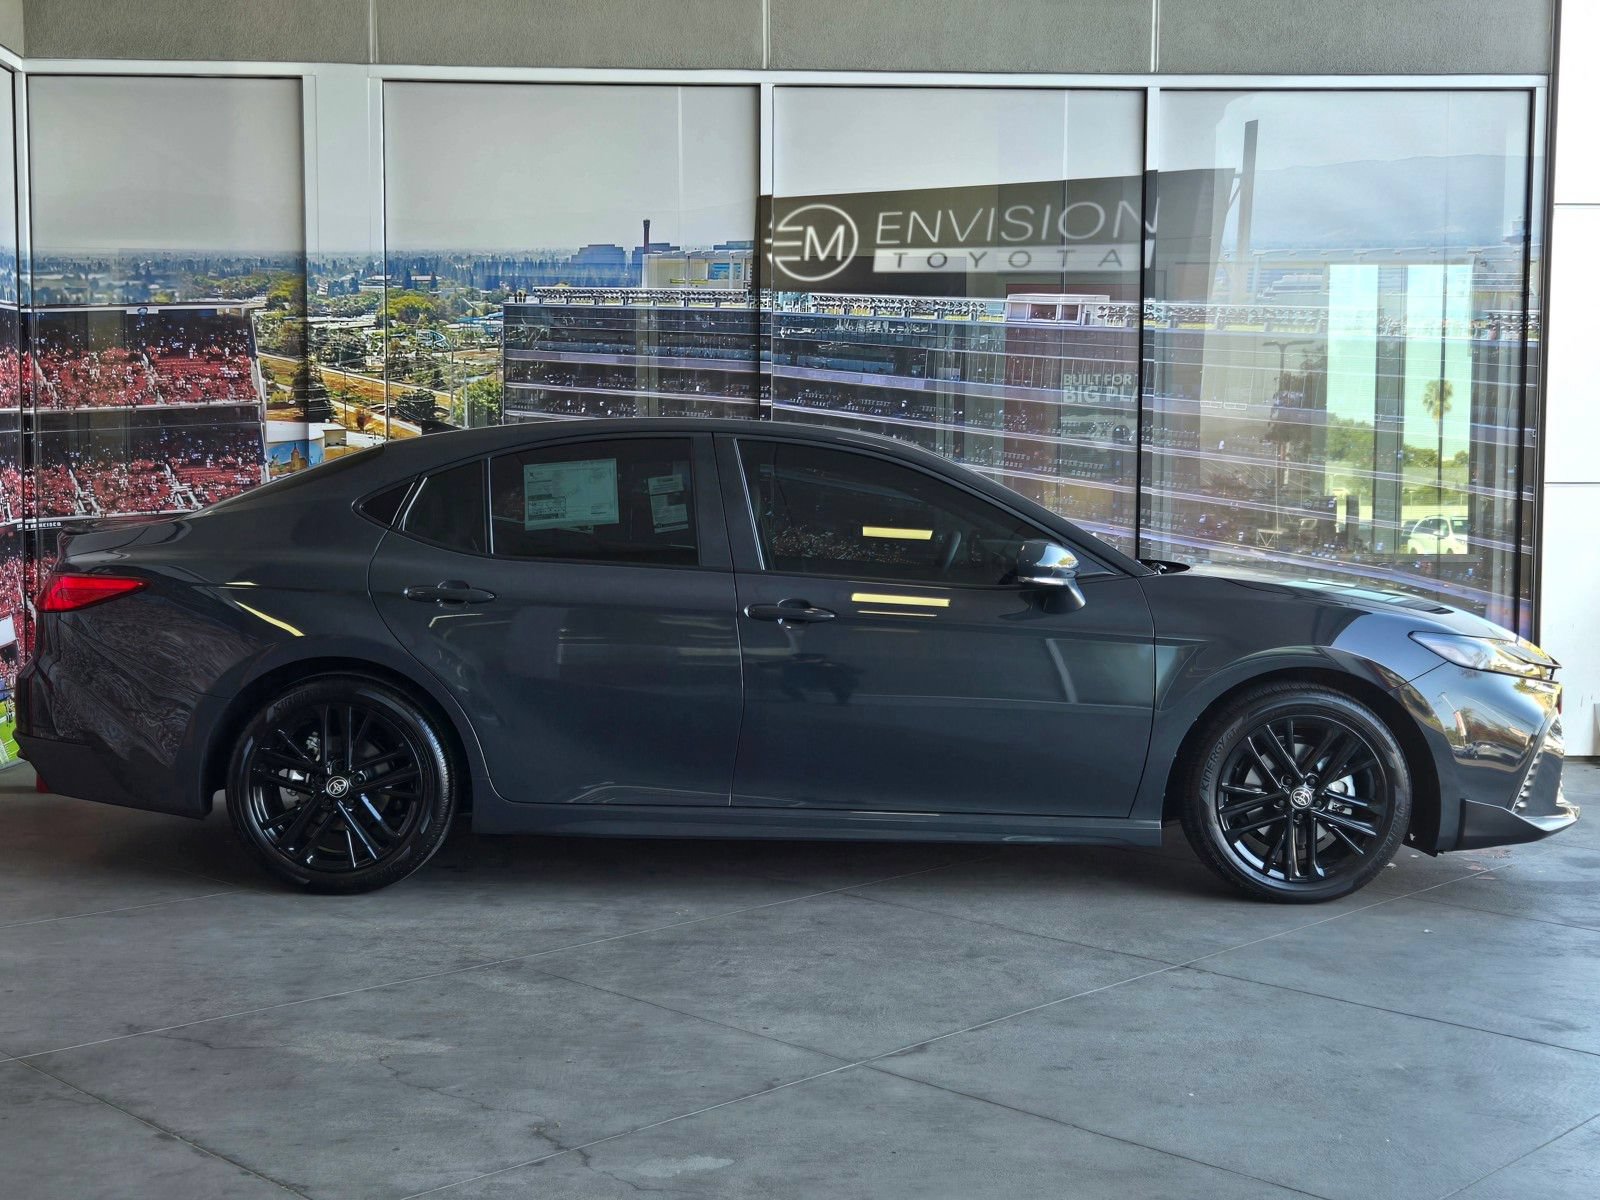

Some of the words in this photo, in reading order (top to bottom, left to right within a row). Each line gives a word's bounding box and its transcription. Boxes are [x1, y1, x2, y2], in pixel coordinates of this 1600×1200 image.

[875, 197, 1160, 245] ENVISION
[893, 249, 1123, 270] TOYOTA
[1063, 373, 1101, 386] BUILT
[1104, 374, 1132, 386] FOR
[1063, 385, 1100, 403] BIG
